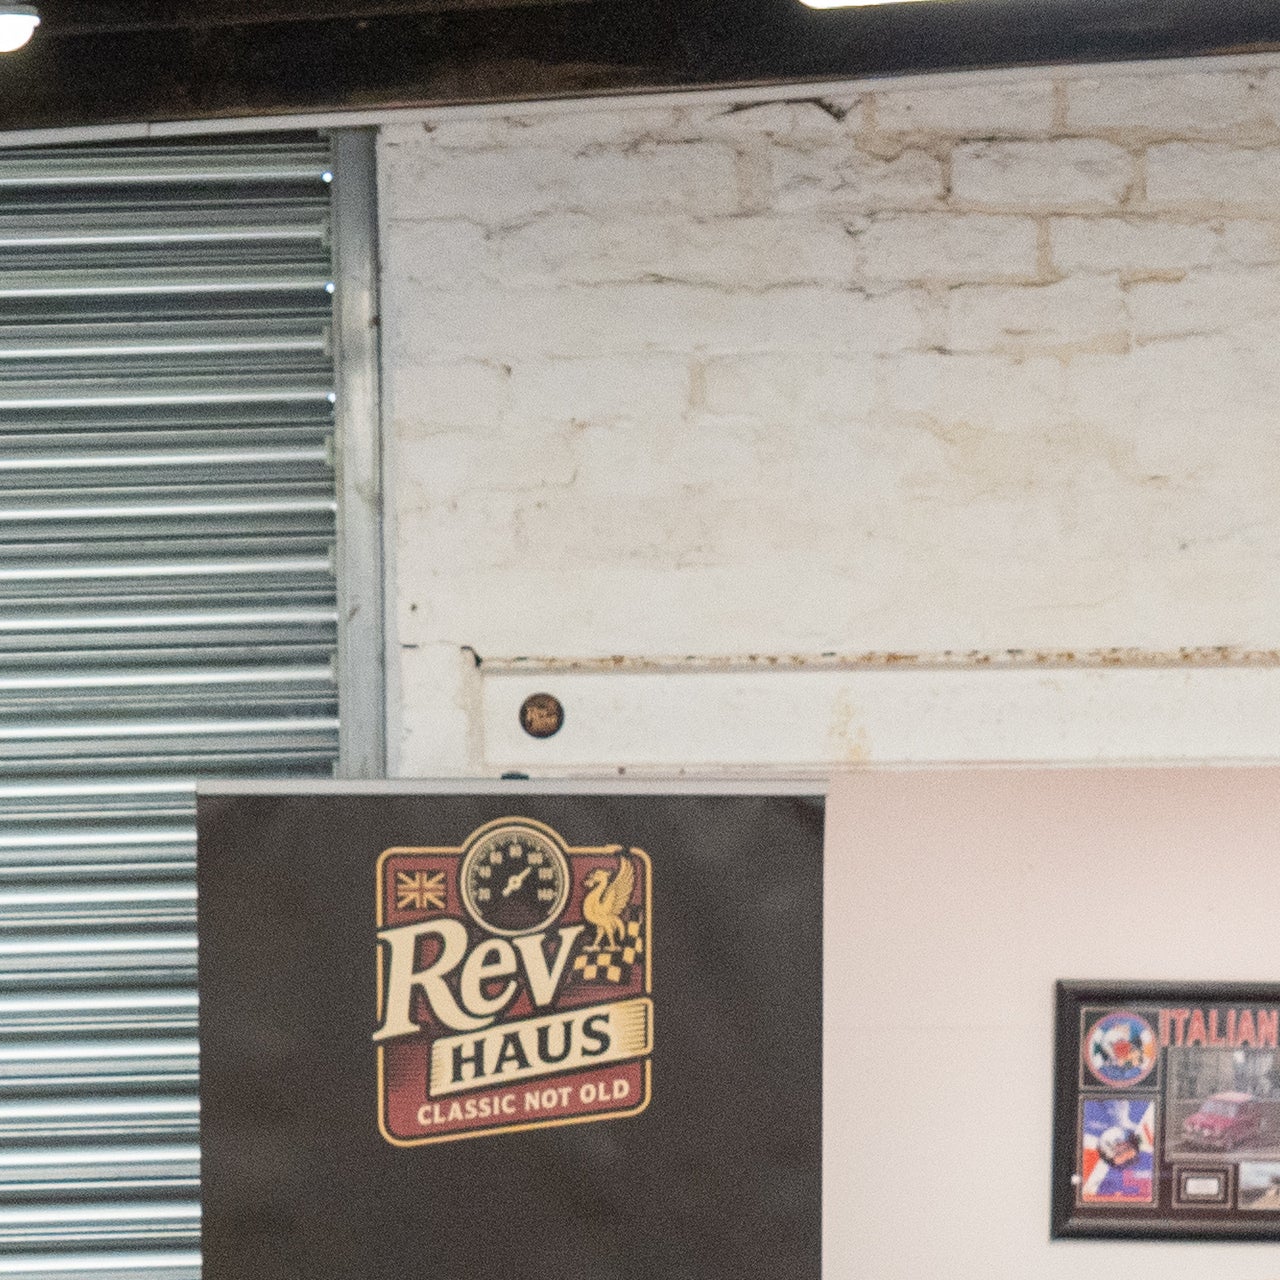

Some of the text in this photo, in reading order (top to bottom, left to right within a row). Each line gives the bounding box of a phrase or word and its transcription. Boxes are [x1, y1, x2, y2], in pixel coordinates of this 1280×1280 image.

[372, 918, 585, 1041] Rev
[451, 1013, 612, 1084] HAUS
[1158, 1009, 1279, 1048] ITALIAN
[417, 1078, 631, 1126] CLASSIC NOT OLD
